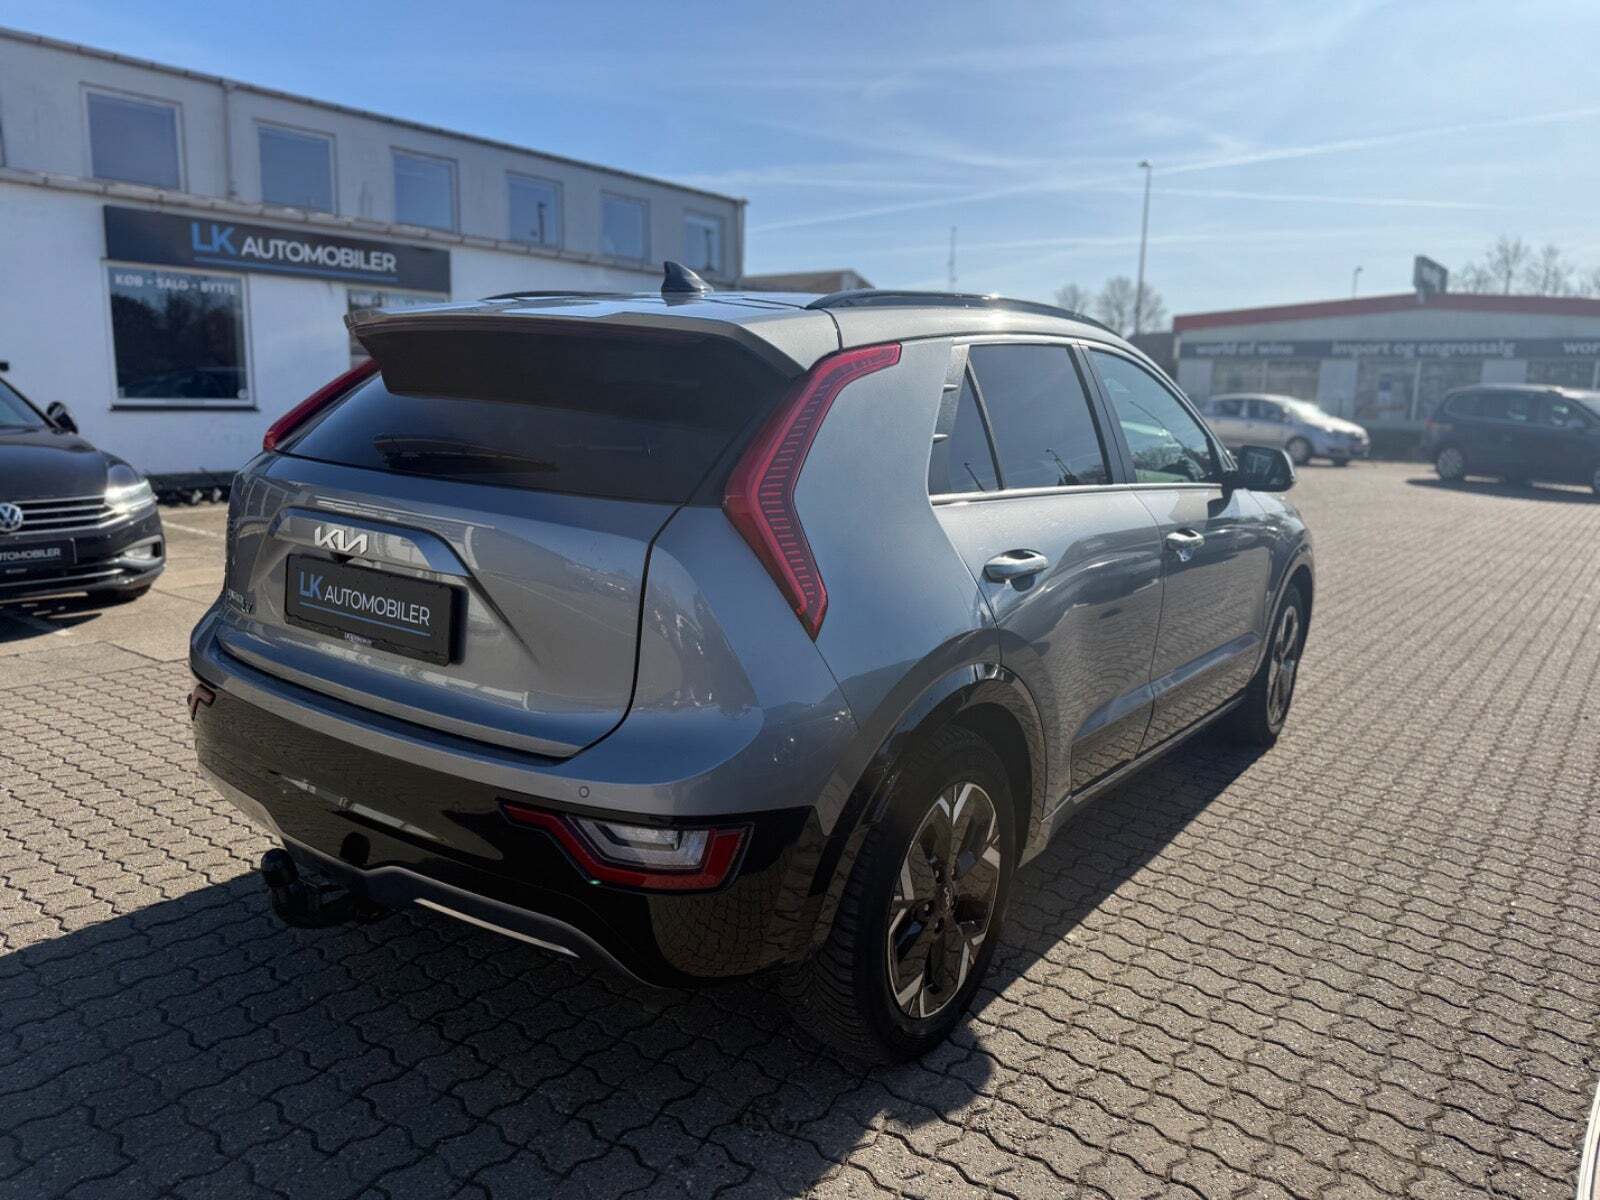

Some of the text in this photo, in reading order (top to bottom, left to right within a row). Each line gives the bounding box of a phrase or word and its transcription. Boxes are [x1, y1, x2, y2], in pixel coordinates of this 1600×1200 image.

[191, 222, 396, 273] LK AUTOMOBILER
[314, 526, 368, 554] KIA
[300, 571, 430, 626] LK AUTOMOBILER
